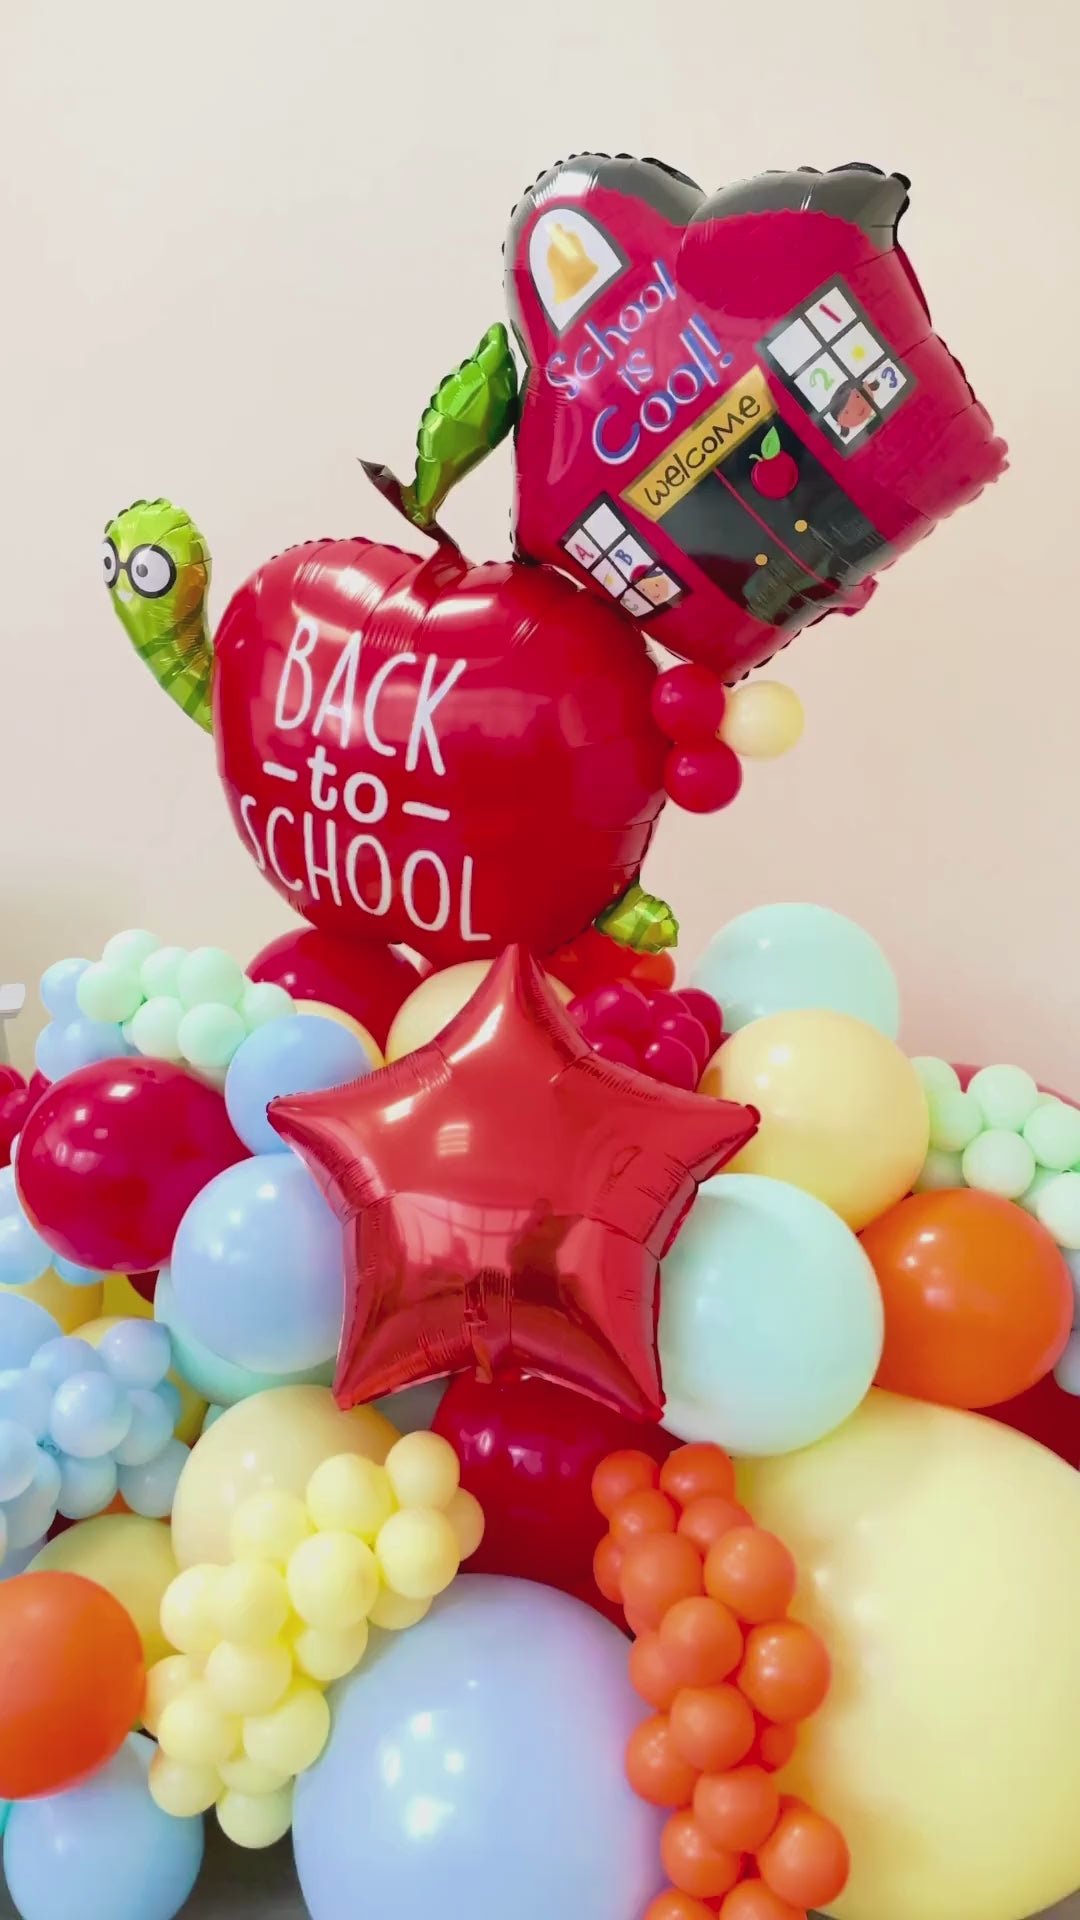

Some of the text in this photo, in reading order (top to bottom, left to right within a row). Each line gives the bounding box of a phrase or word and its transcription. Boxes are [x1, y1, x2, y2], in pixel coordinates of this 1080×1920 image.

[546, 259, 678, 400] School
[592, 313, 734, 465] Cool!
[617, 348, 654, 395] is
[809, 367, 835, 391] 2
[881, 366, 898, 389] 3
[574, 543, 595, 560] A
[614, 548, 633, 566] B
[274, 618, 467, 776] BACK
[240, 794, 491, 941] SCHOOL
